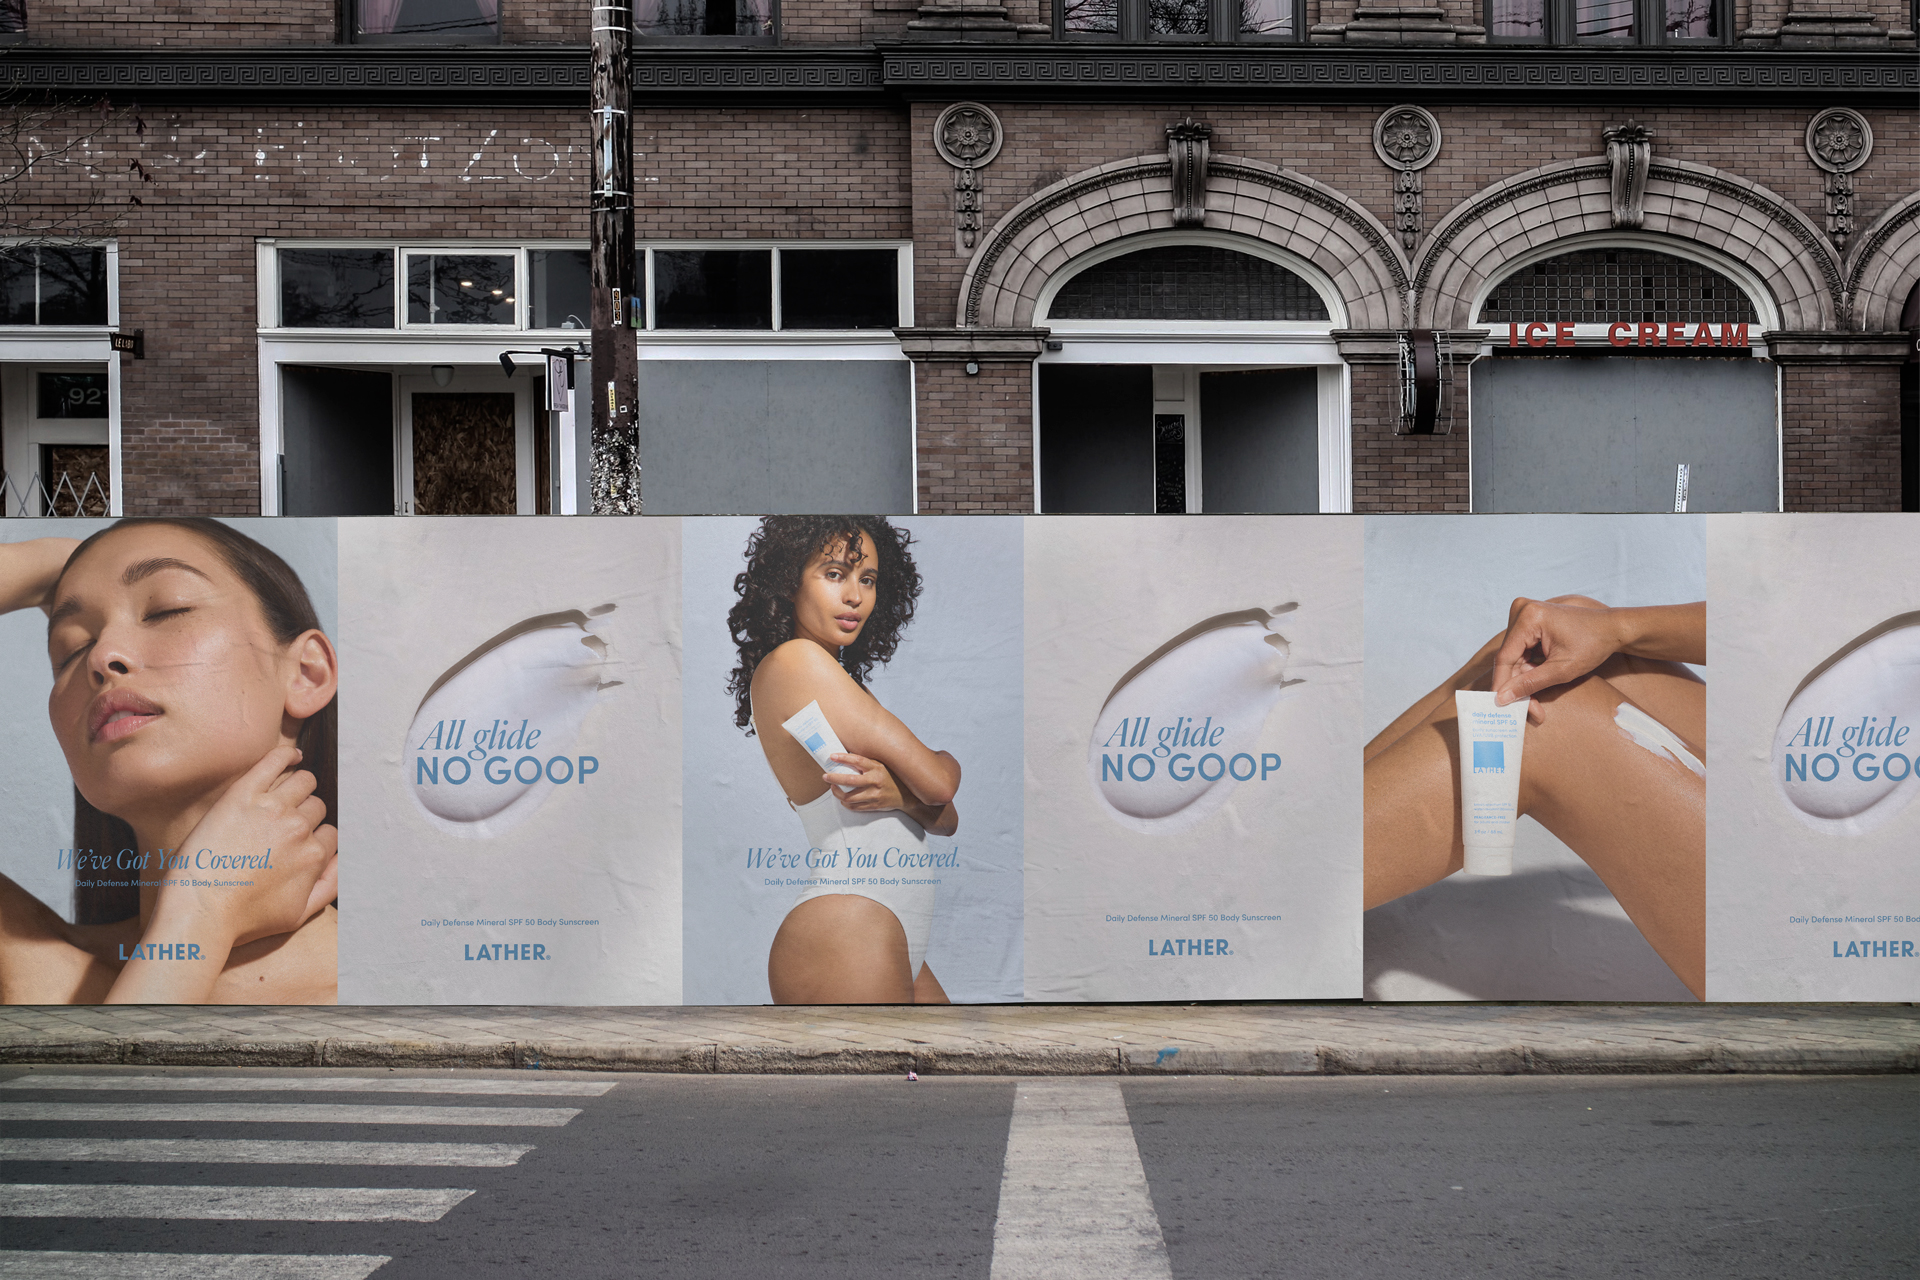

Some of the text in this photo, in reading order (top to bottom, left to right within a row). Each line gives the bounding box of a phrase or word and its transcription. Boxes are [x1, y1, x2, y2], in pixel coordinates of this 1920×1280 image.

[115, 338, 122, 348] LE
[1509, 321, 1749, 347] ICE CREAM
[69, 387, 108, 405] 92
[1472, 711, 1486, 719] daily
[417, 719, 542, 761] All glide
[1102, 716, 1225, 758] All glide
[1785, 716, 1910, 758] All glide
[416, 755, 599, 785] NO GOOP
[1102, 752, 1282, 782] NO GOOP
[1785, 752, 1920, 782] NO GO
[57, 848, 273, 870] We've Got You Covered.
[746, 846, 960, 869] We've Got You Covered.
[75, 879, 95, 888] Daily
[97, 879, 129, 887] Defense
[131, 879, 161, 887] Mineral
[163, 879, 178, 887] SPF
[192, 879, 212, 888] Body
[213, 879, 254, 887] Sunscreen
[764, 878, 784, 887] Daily
[786, 878, 818, 886] Defense
[879, 877, 900, 887] Body
[901, 877, 942, 885] Sunscreen
[420, 919, 441, 928] Daily
[508, 918, 523, 926] SPF
[537, 919, 556, 927] Body
[559, 918, 599, 926] Sunscreen
[1105, 914, 1126, 923] Daily
[1127, 914, 1159, 922] Defense
[1160, 914, 1191, 922] Mineral
[1220, 914, 1240, 923] Body
[1241, 913, 1282, 921] Sunscreen
[1789, 916, 1809, 925] Daily
[1845, 915, 1875, 923] Mineral
[1877, 915, 1892, 923] SPF
